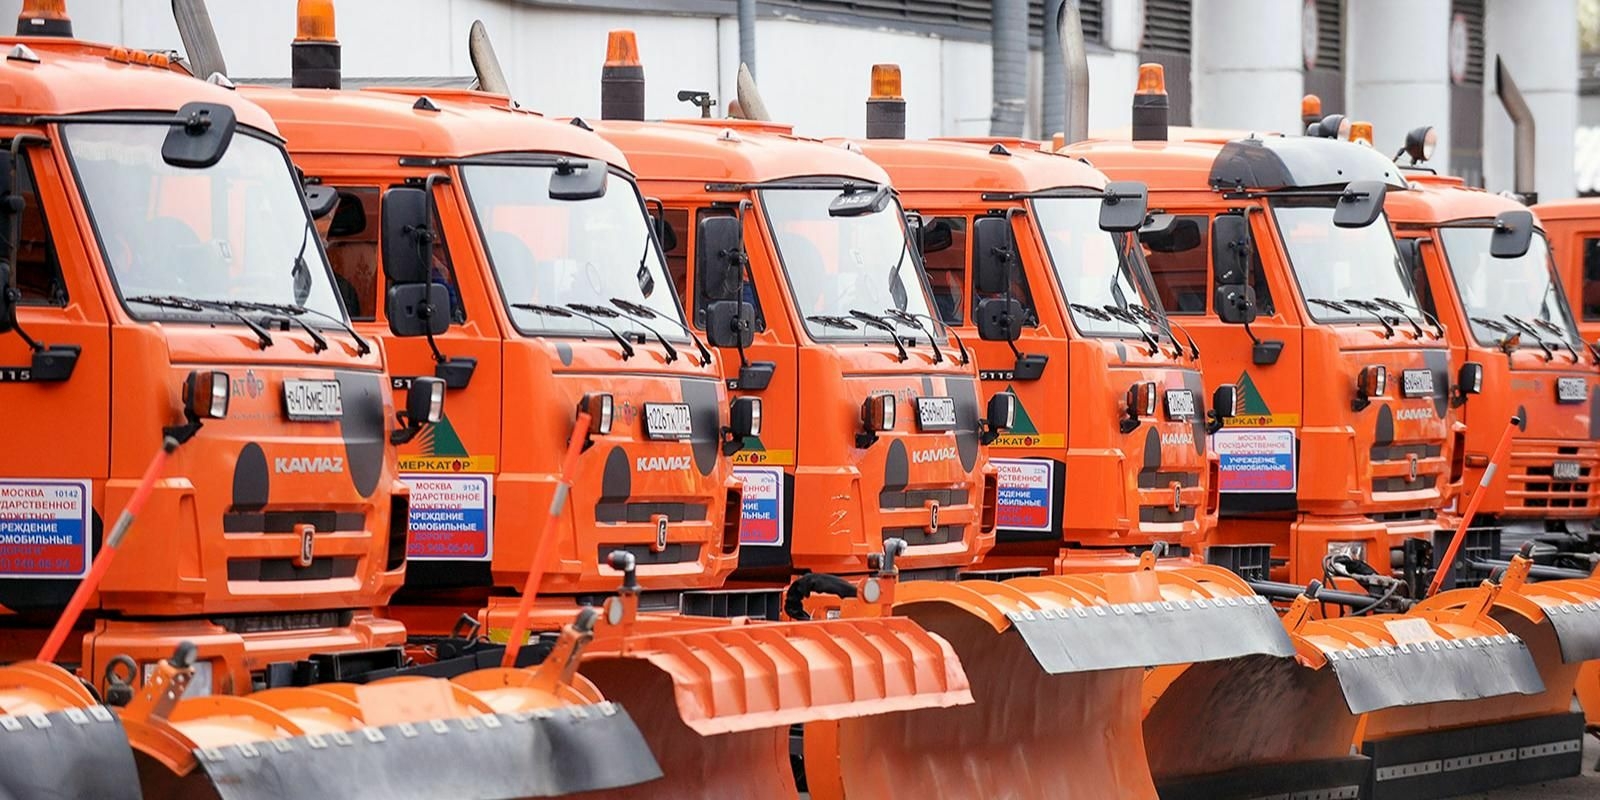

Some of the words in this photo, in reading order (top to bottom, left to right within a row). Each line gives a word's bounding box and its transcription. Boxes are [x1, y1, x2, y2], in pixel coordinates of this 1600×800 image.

[1396, 407, 1433, 421] KAMAZ
[1224, 416, 1273, 426] ЕРКАТОР
[1162, 431, 1194, 446] KAMAZ
[736, 452, 767, 464] АТОР
[912, 447, 957, 463] KAMAZ
[274, 456, 344, 474] KAMAZ
[636, 456, 692, 472] KAMAZ
[998, 465, 1022, 473] ОСКВА
[998, 474, 1043, 483] РСТВЕННОЕ
[415, 482, 453, 490] МОСКВА
[1, 488, 45, 498] МОСКВА
[55, 490, 79, 498] 10142
[0, 500, 77, 510] ДАРСТВЕННОЕ
[998, 498, 1042, 507] ОБИЛЬНЫЕ
[0, 522, 58, 533] РЕЖДЕНИЕ
